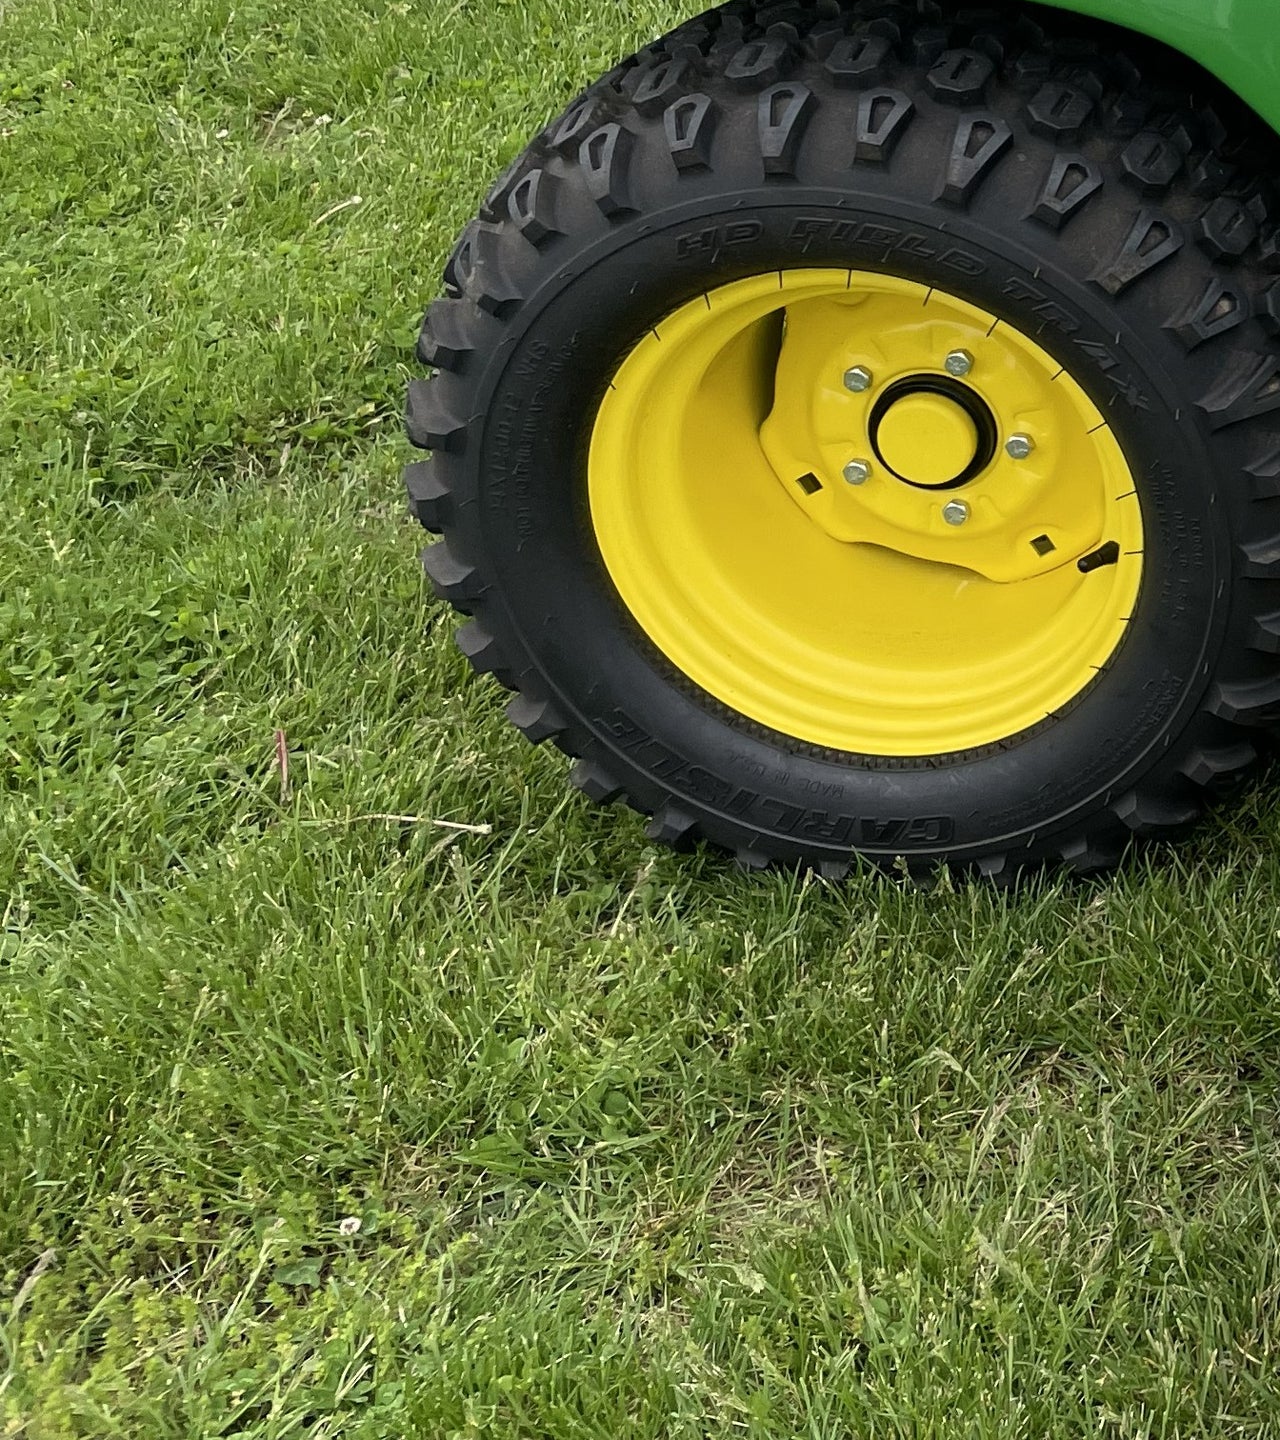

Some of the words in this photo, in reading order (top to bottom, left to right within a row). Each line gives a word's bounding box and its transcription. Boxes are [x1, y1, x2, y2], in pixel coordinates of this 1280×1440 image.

[674, 219, 764, 259] HD
[786, 216, 986, 276] FIELD
[1001, 276, 1151, 411] TRAX
[591, 706, 955, 846] CARLISLE
[799, 777, 846, 799] MADE
